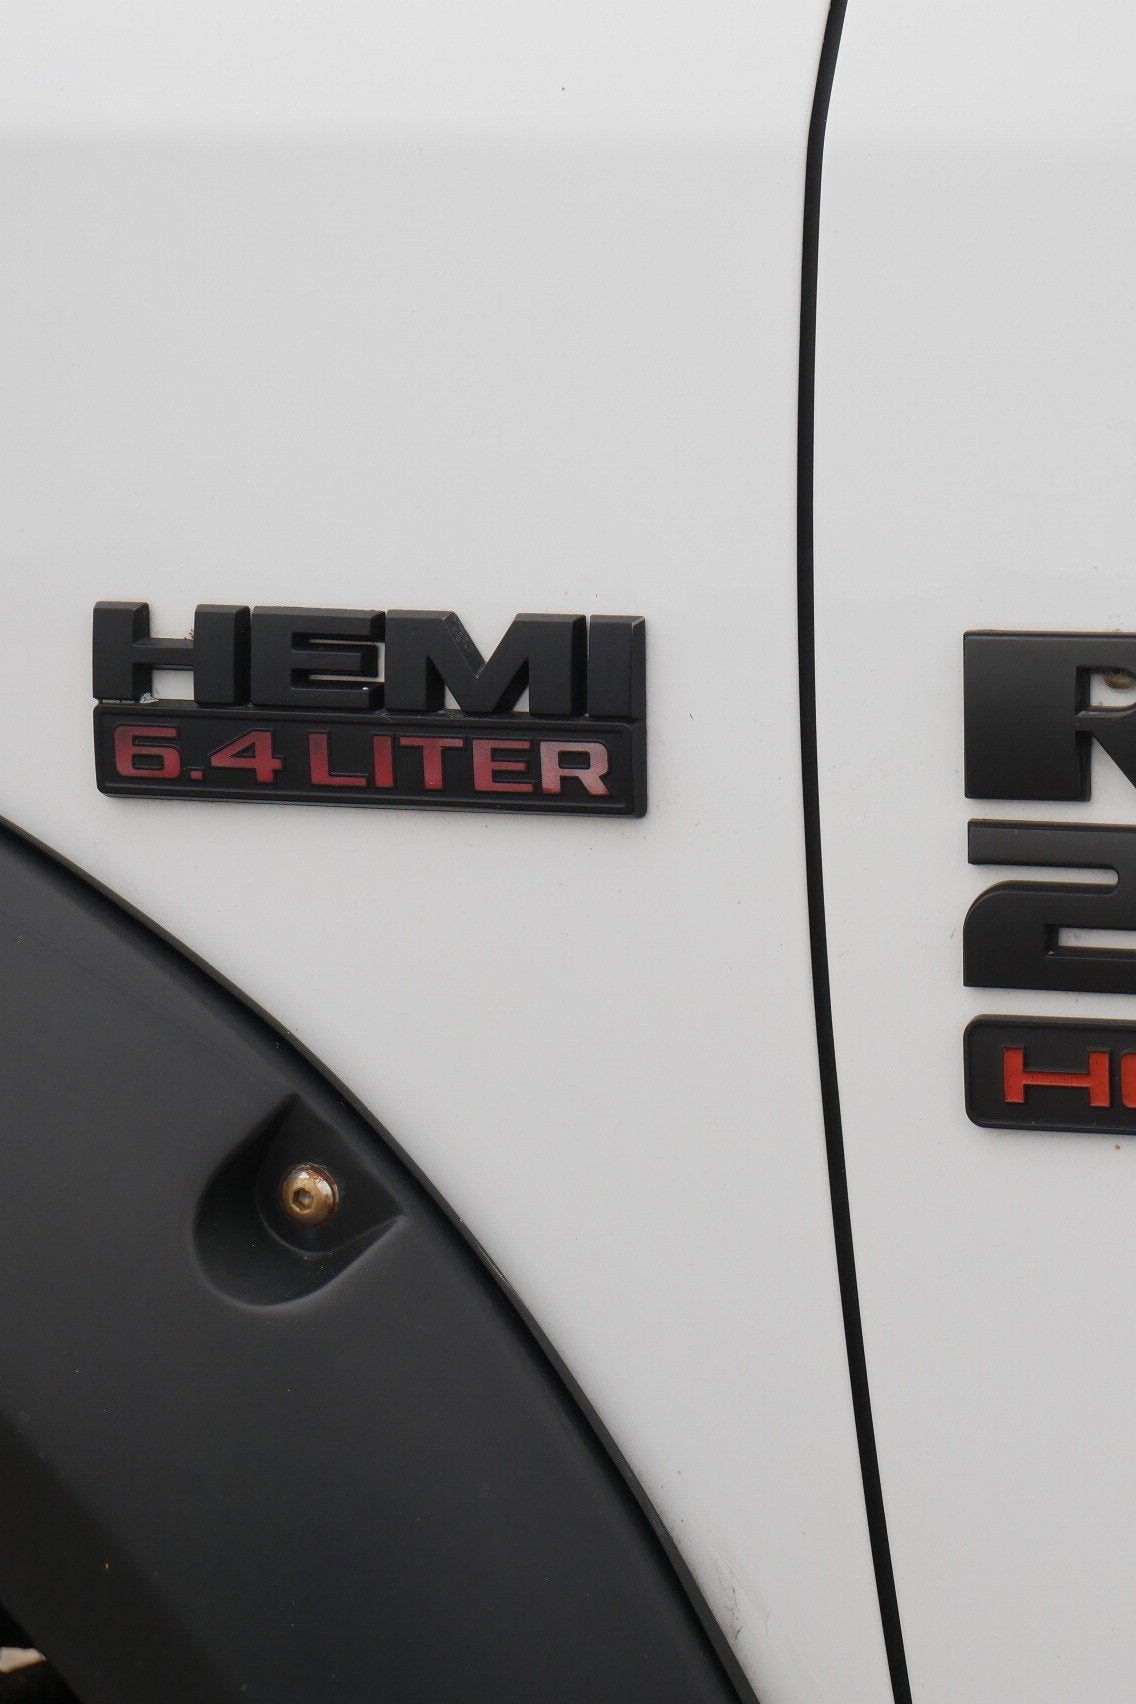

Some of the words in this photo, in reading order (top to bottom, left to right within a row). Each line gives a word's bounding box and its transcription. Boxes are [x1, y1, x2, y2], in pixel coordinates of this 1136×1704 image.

[92, 600, 646, 717] HEMI
[113, 724, 283, 783] 6.4
[308, 731, 610, 796] LITER
